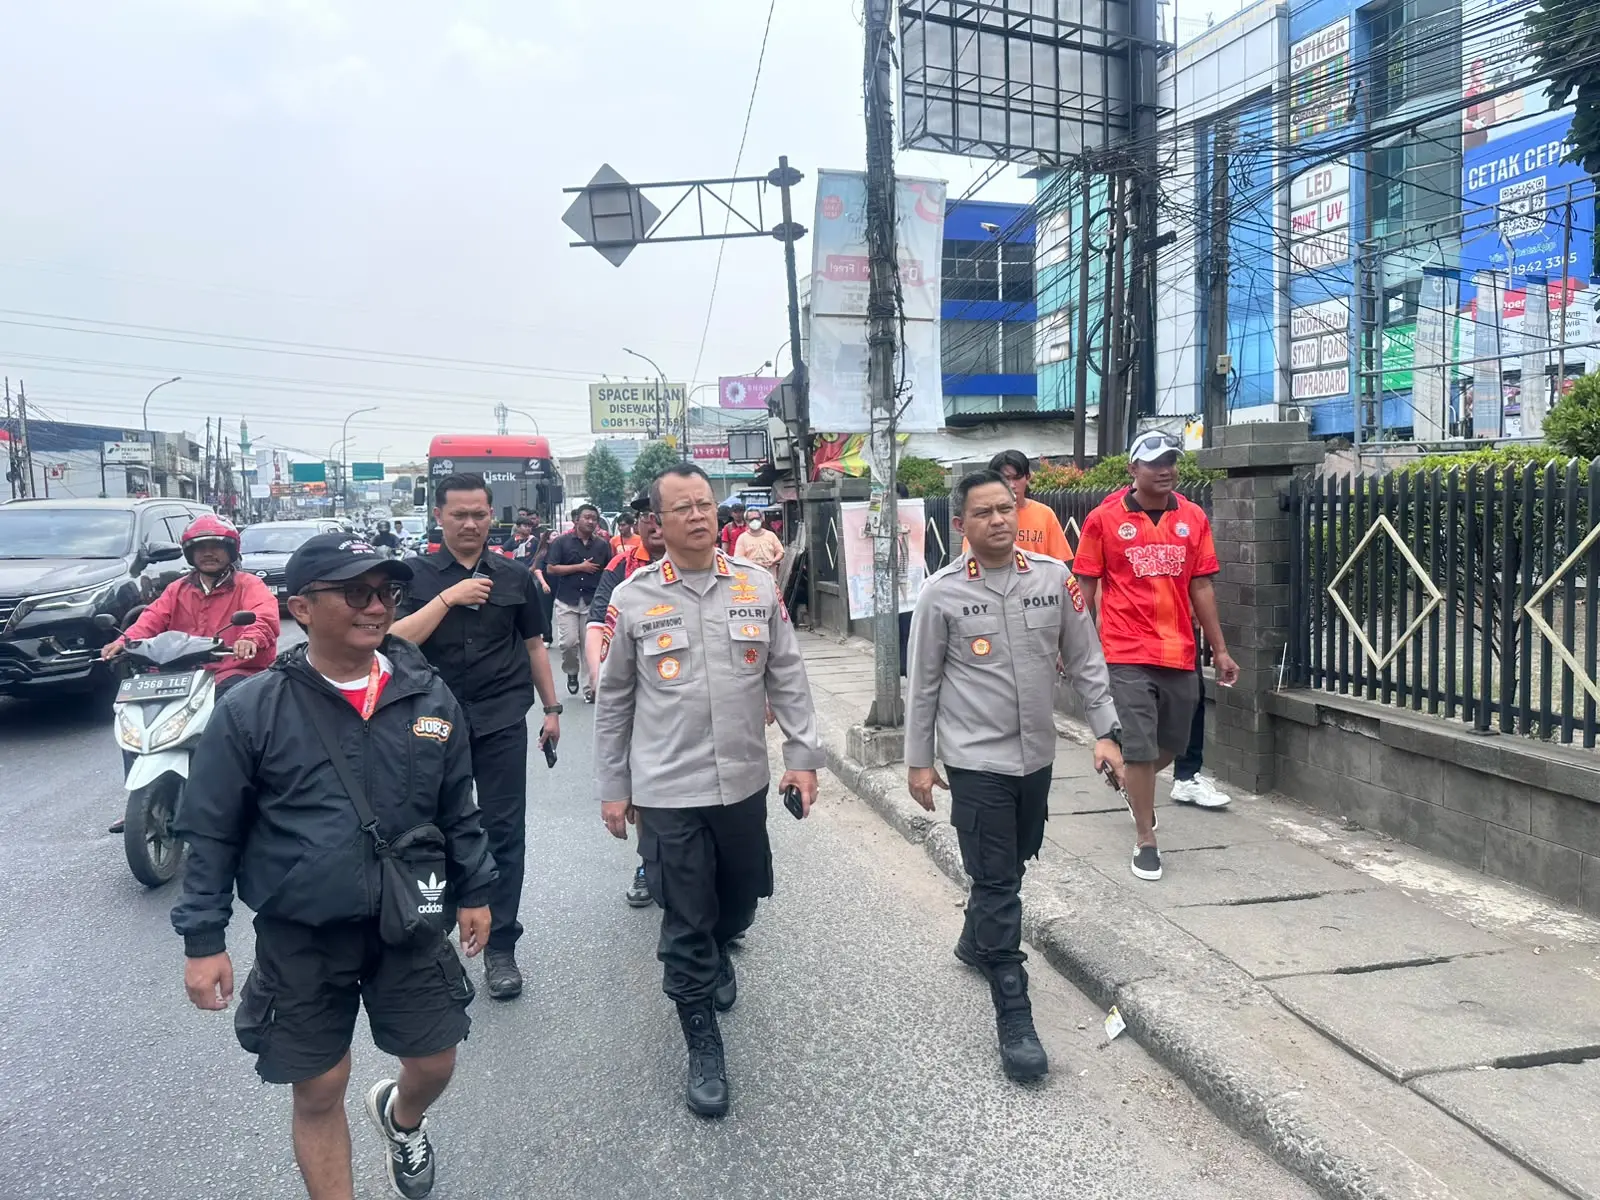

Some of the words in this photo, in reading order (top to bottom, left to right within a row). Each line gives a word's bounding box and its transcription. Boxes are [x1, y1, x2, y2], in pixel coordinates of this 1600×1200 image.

[1294, 25, 1346, 69] STIKER
[1468, 153, 1520, 190] CETAK
[1306, 170, 1332, 198] LED
[1293, 210, 1316, 232] PRINT
[1327, 201, 1342, 222] UV
[1293, 232, 1347, 270] ACRYLIC
[1545, 252, 1577, 270] 335
[1293, 311, 1346, 335] UNDANGAN
[1293, 343, 1316, 365] STYRO
[1295, 369, 1346, 397] IMPRABOARD
[598, 388, 638, 401] SPACE
[962, 604, 988, 616] BOY
[1023, 595, 1060, 608] POLRI
[728, 609, 766, 618] POLRI
[168, 677, 188, 687] TLE
[417, 902, 443, 914] adidas
